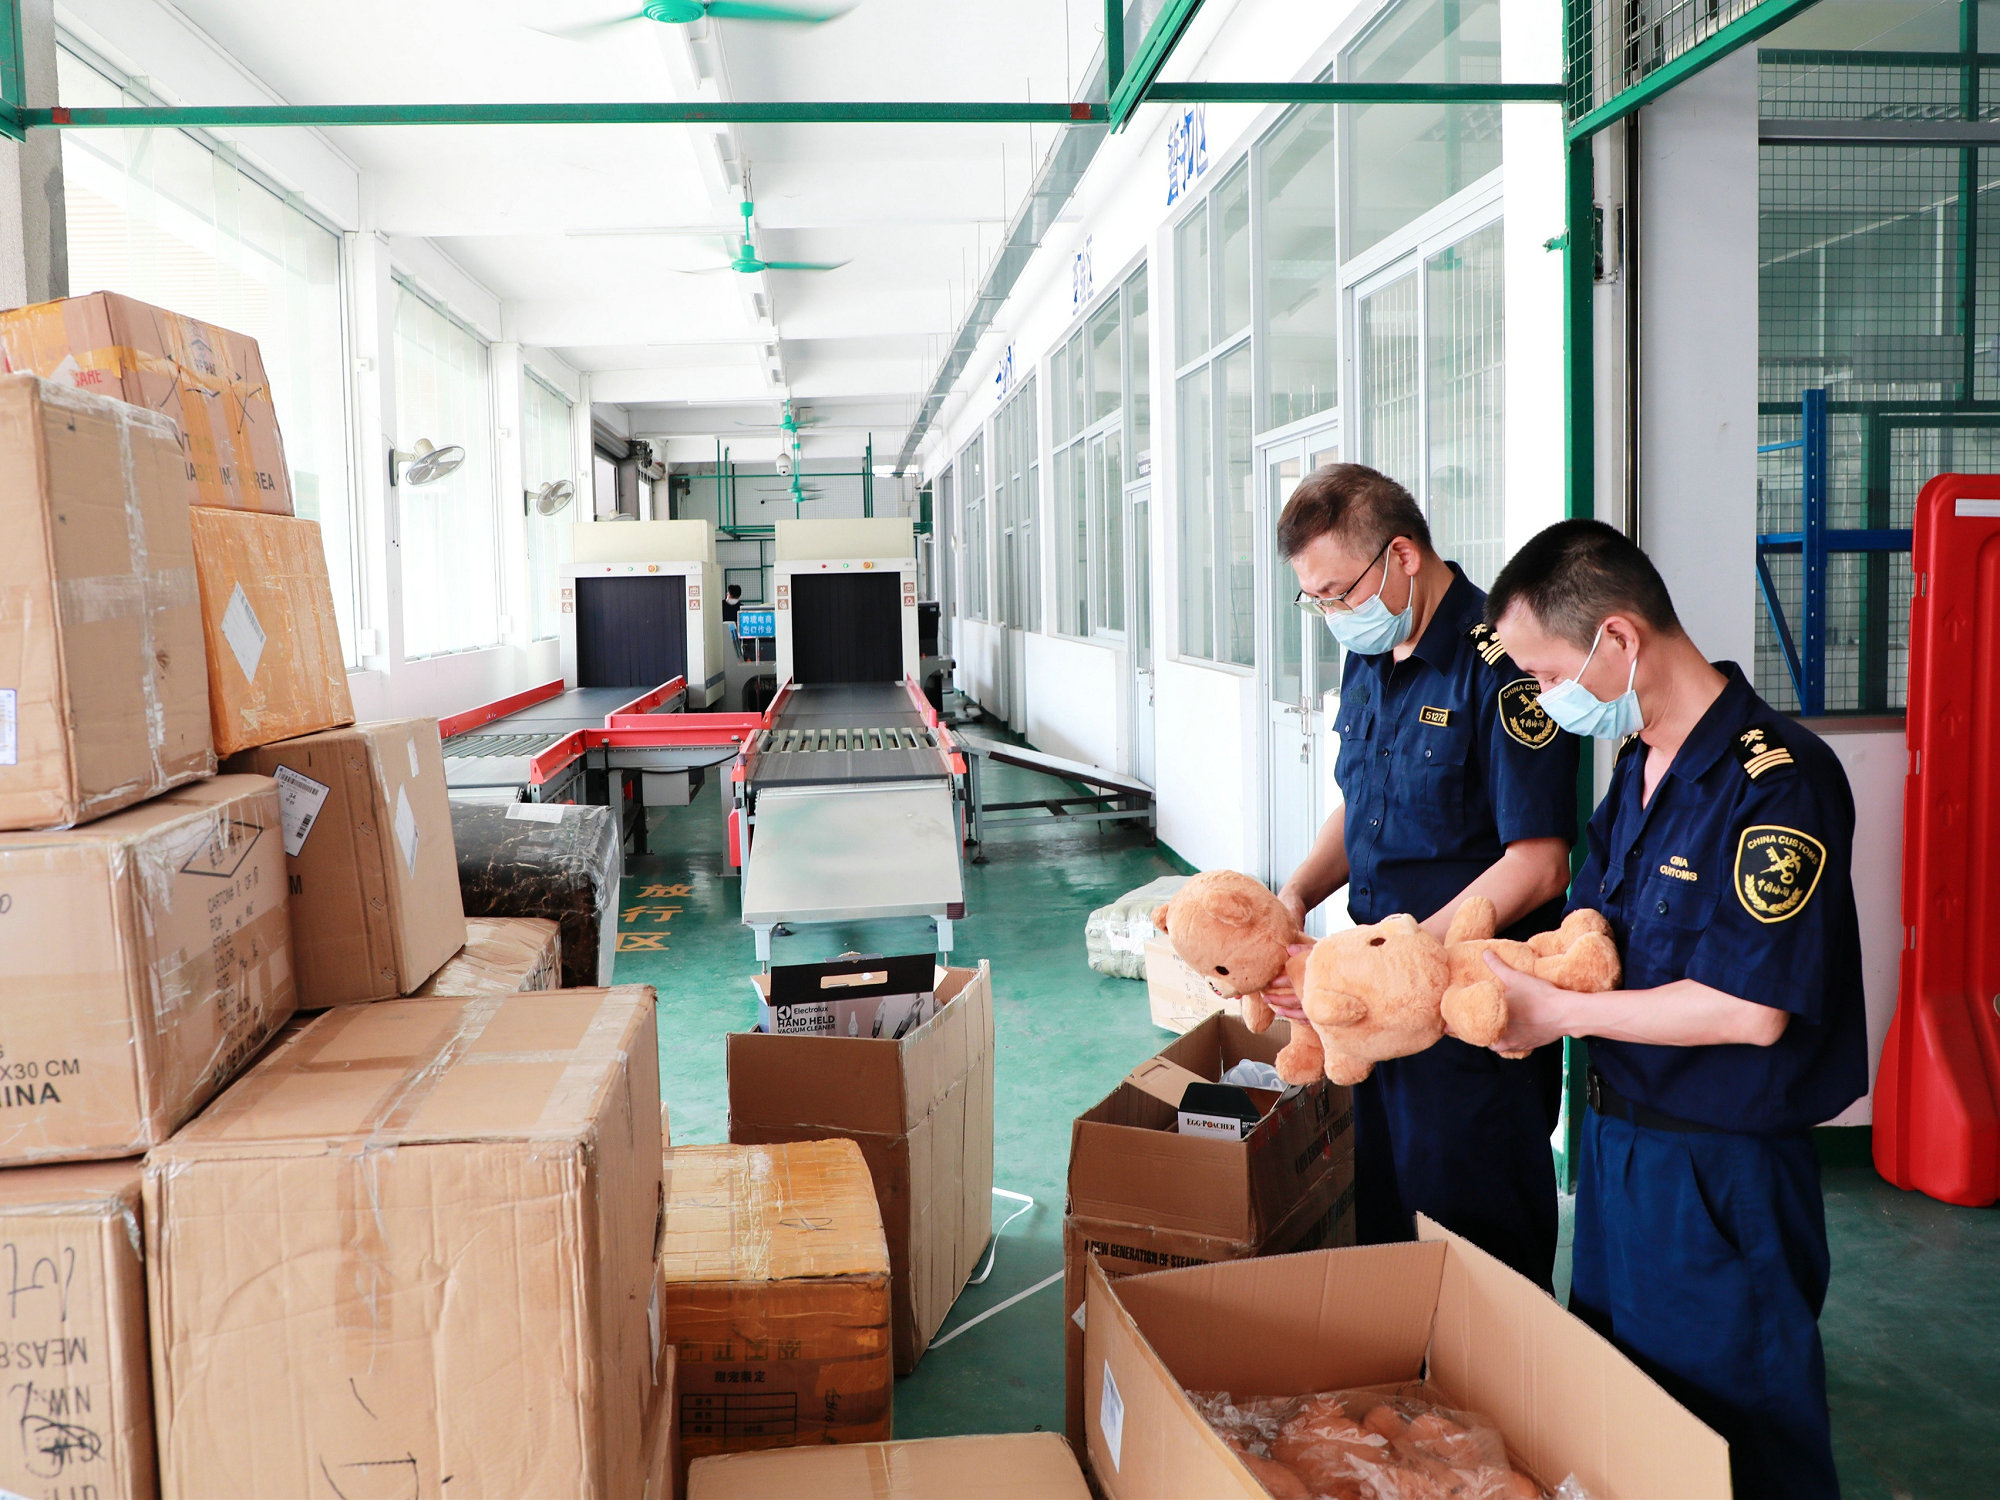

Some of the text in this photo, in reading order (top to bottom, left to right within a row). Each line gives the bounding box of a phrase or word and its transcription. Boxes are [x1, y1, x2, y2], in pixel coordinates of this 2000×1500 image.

[742, 615, 772, 625] 跨境电商
[742, 625, 772, 635] 出口作业
[1747, 835, 1819, 865] CHINA CUSTOMS
[794, 1006, 829, 1015] Electrolux
[777, 1015, 835, 1028] HAND HELD
[777, 1023, 836, 1034] VACUUM CLEANER
[45, 1058, 80, 1077] CM
[0, 1082, 62, 1108] INA
[1110, 1243, 1158, 1265] GENERATION
[1159, 1253, 1169, 1267] OF
